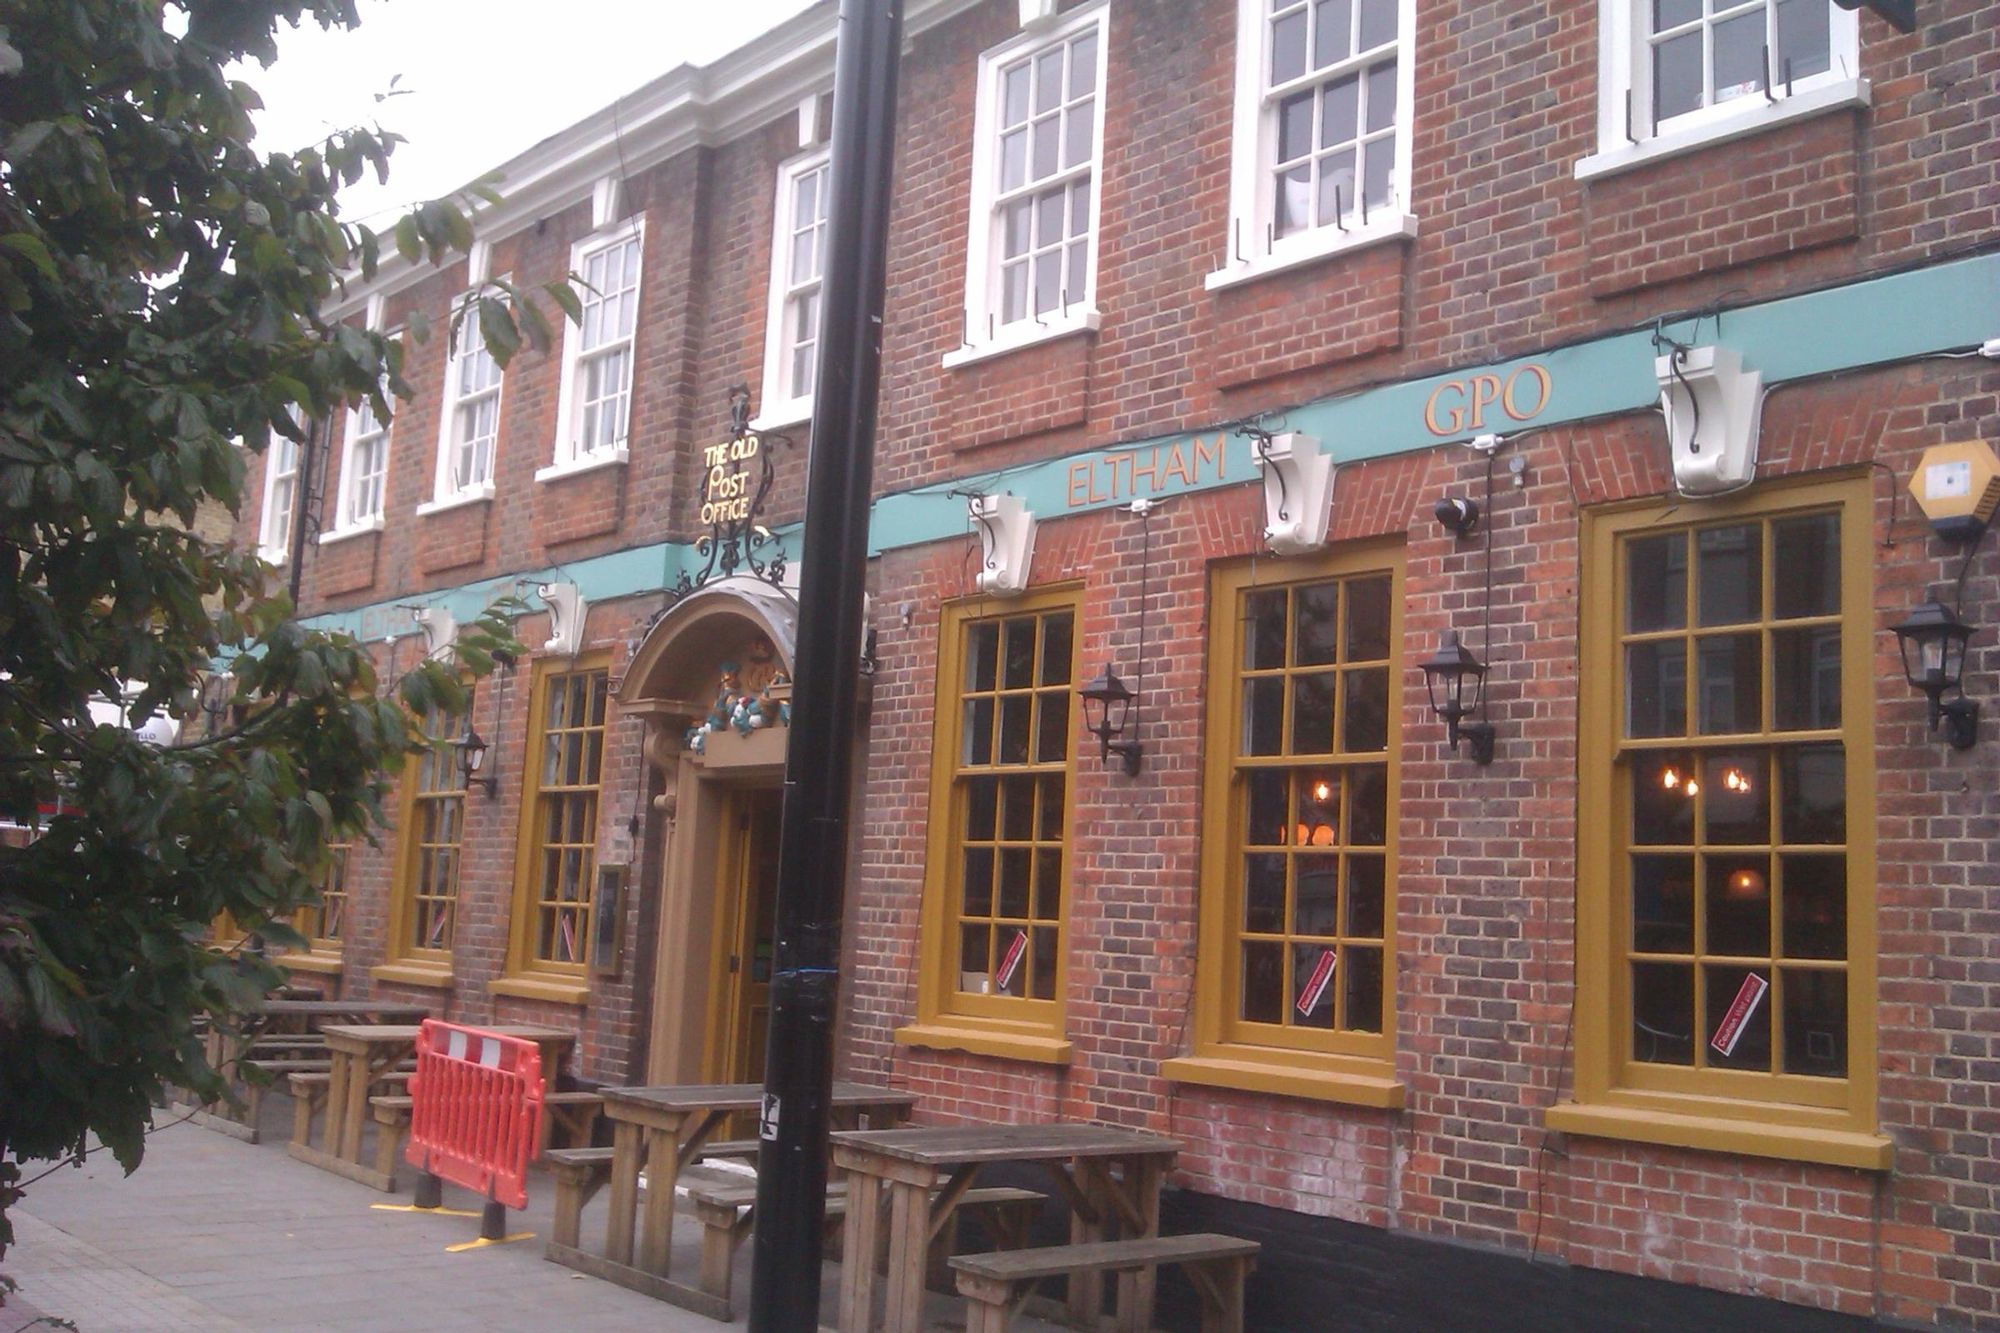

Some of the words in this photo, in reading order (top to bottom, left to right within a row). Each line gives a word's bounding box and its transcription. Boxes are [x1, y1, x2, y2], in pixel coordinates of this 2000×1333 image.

[1424, 364, 1552, 436] GPO
[704, 442, 729, 468] THE
[731, 436, 759, 460] OLD
[1068, 431, 1226, 508] ELTHAM
